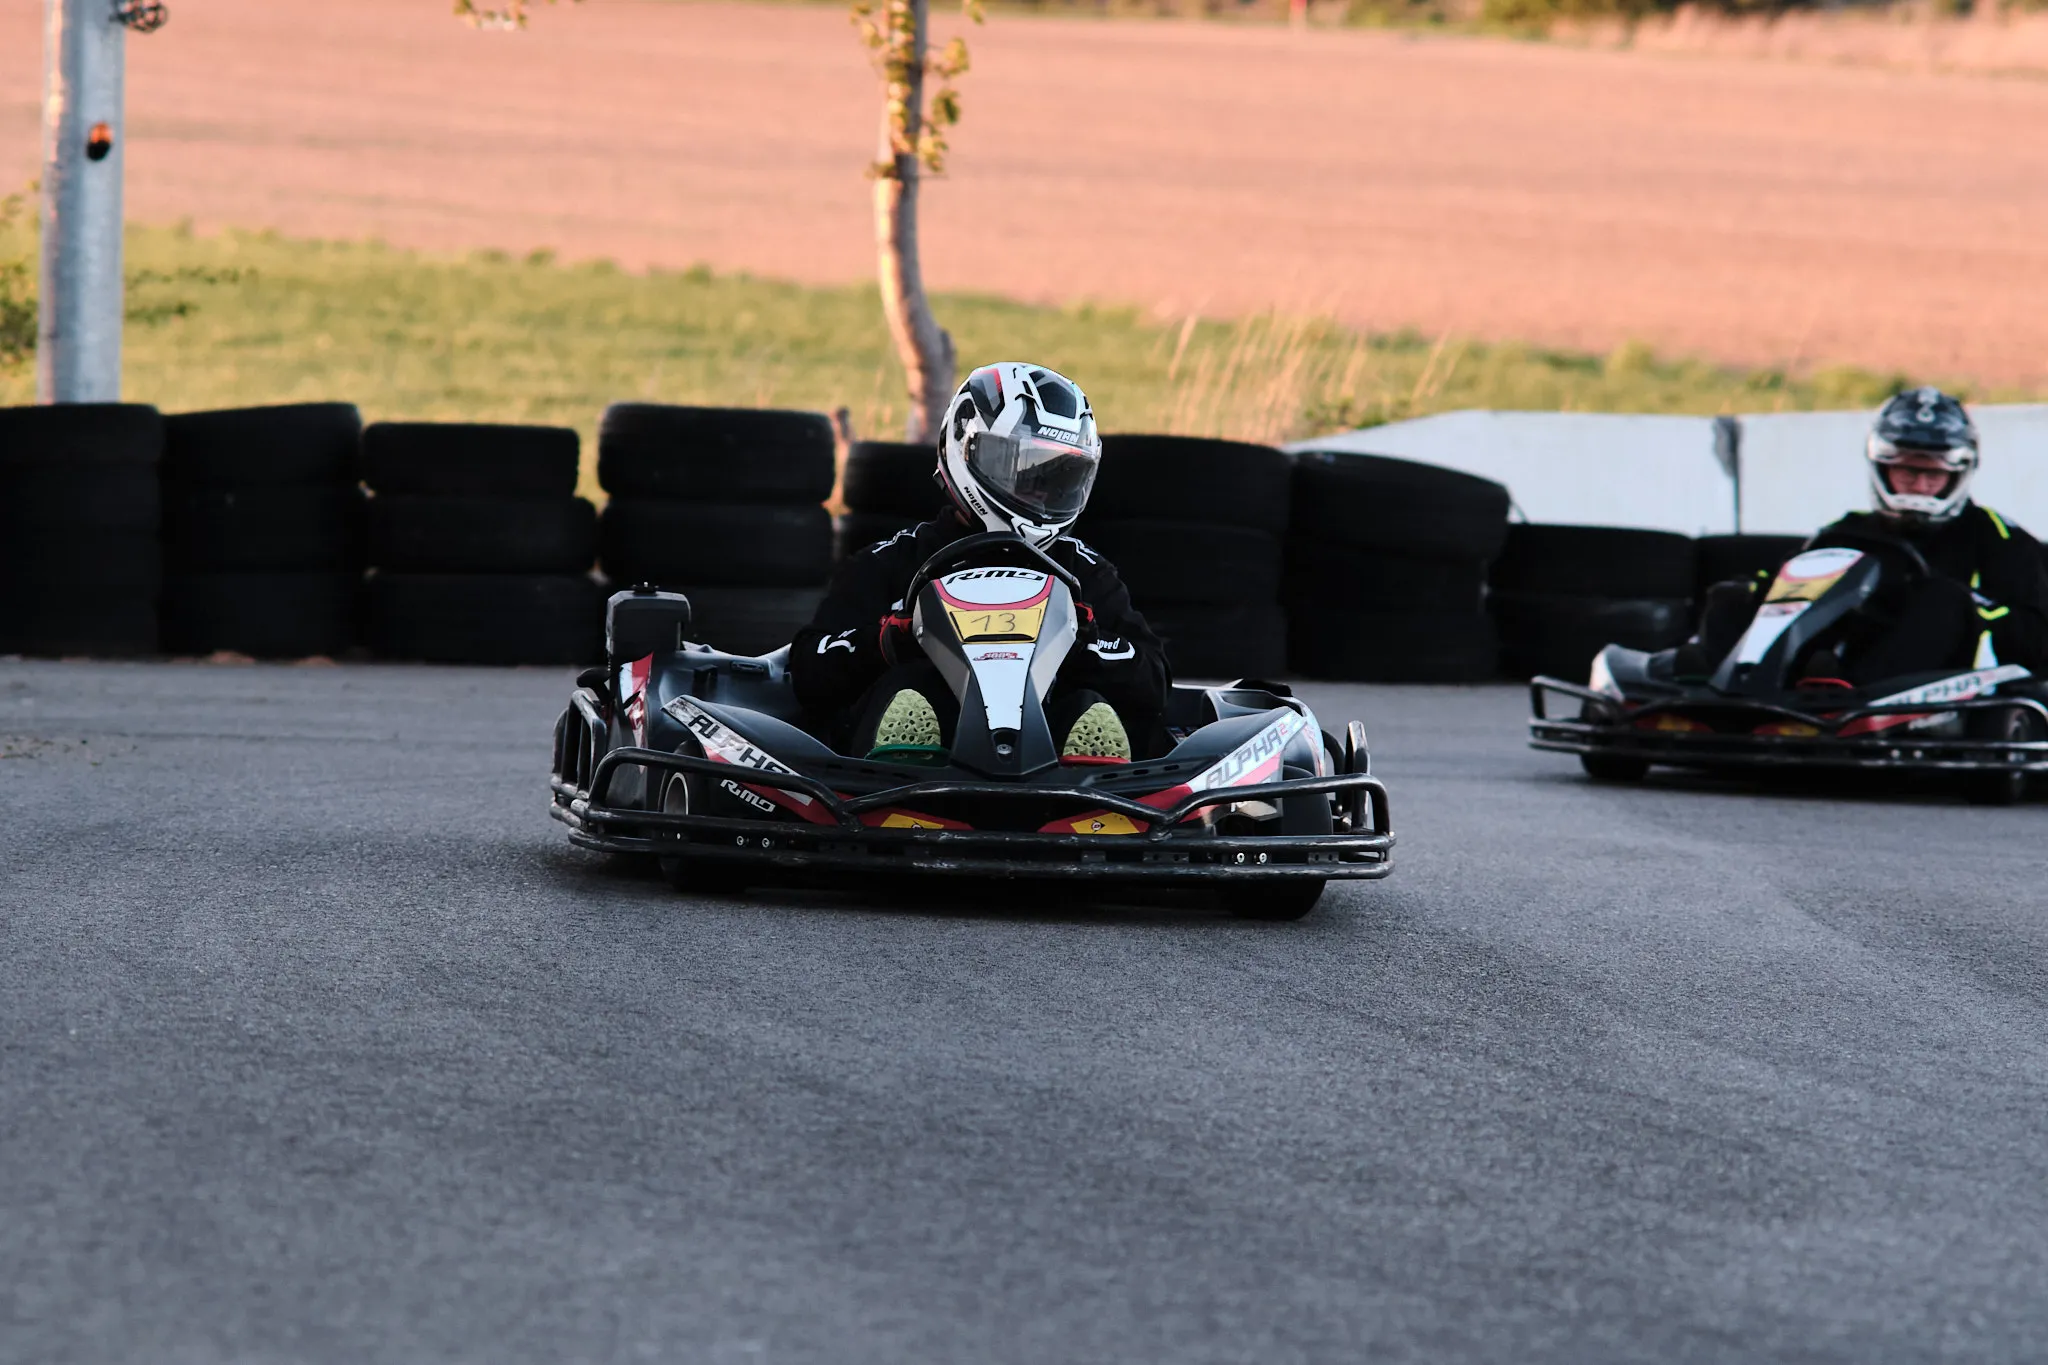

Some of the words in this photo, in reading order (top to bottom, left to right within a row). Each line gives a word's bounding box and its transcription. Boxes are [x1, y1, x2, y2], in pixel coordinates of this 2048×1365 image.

[1038, 425, 1080, 443] NOLAN
[963, 486, 988, 516] NOLAN
[970, 612, 1016, 632] 13
[688, 714, 790, 774] ALHA
